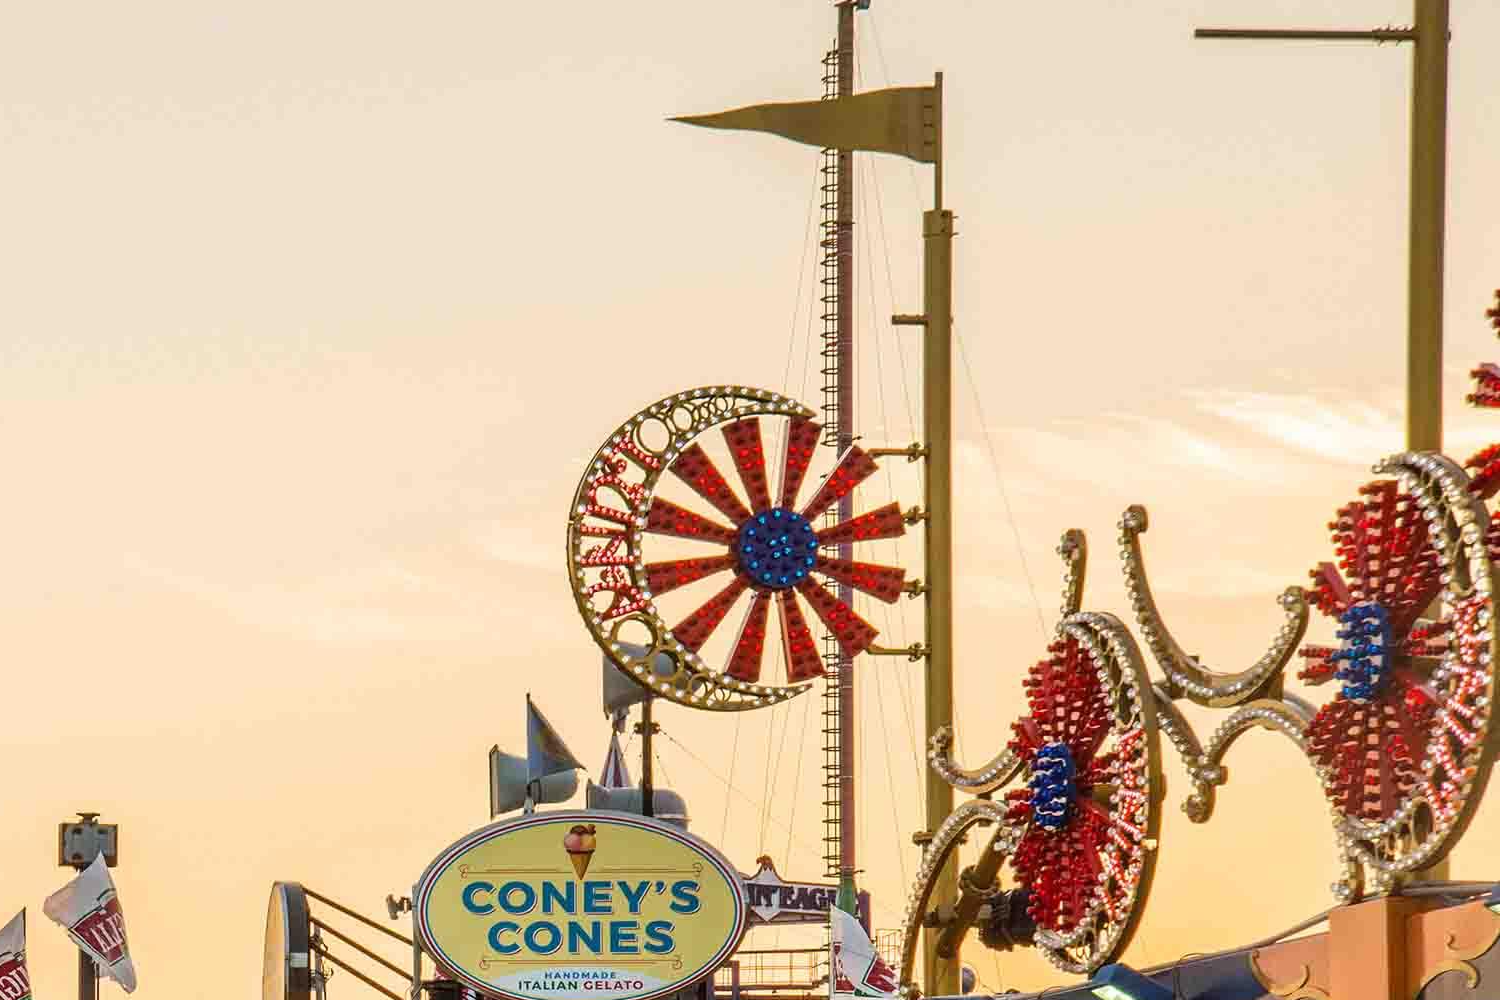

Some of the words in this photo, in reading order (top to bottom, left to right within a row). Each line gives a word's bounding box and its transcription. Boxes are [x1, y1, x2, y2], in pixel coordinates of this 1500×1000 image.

[461, 880, 701, 915] CONEY'S
[487, 920, 675, 955] CONES
[518, 980, 578, 991] ITALIAN
[583, 980, 644, 991] GELATO
[545, 971, 617, 979] HANDMADE
